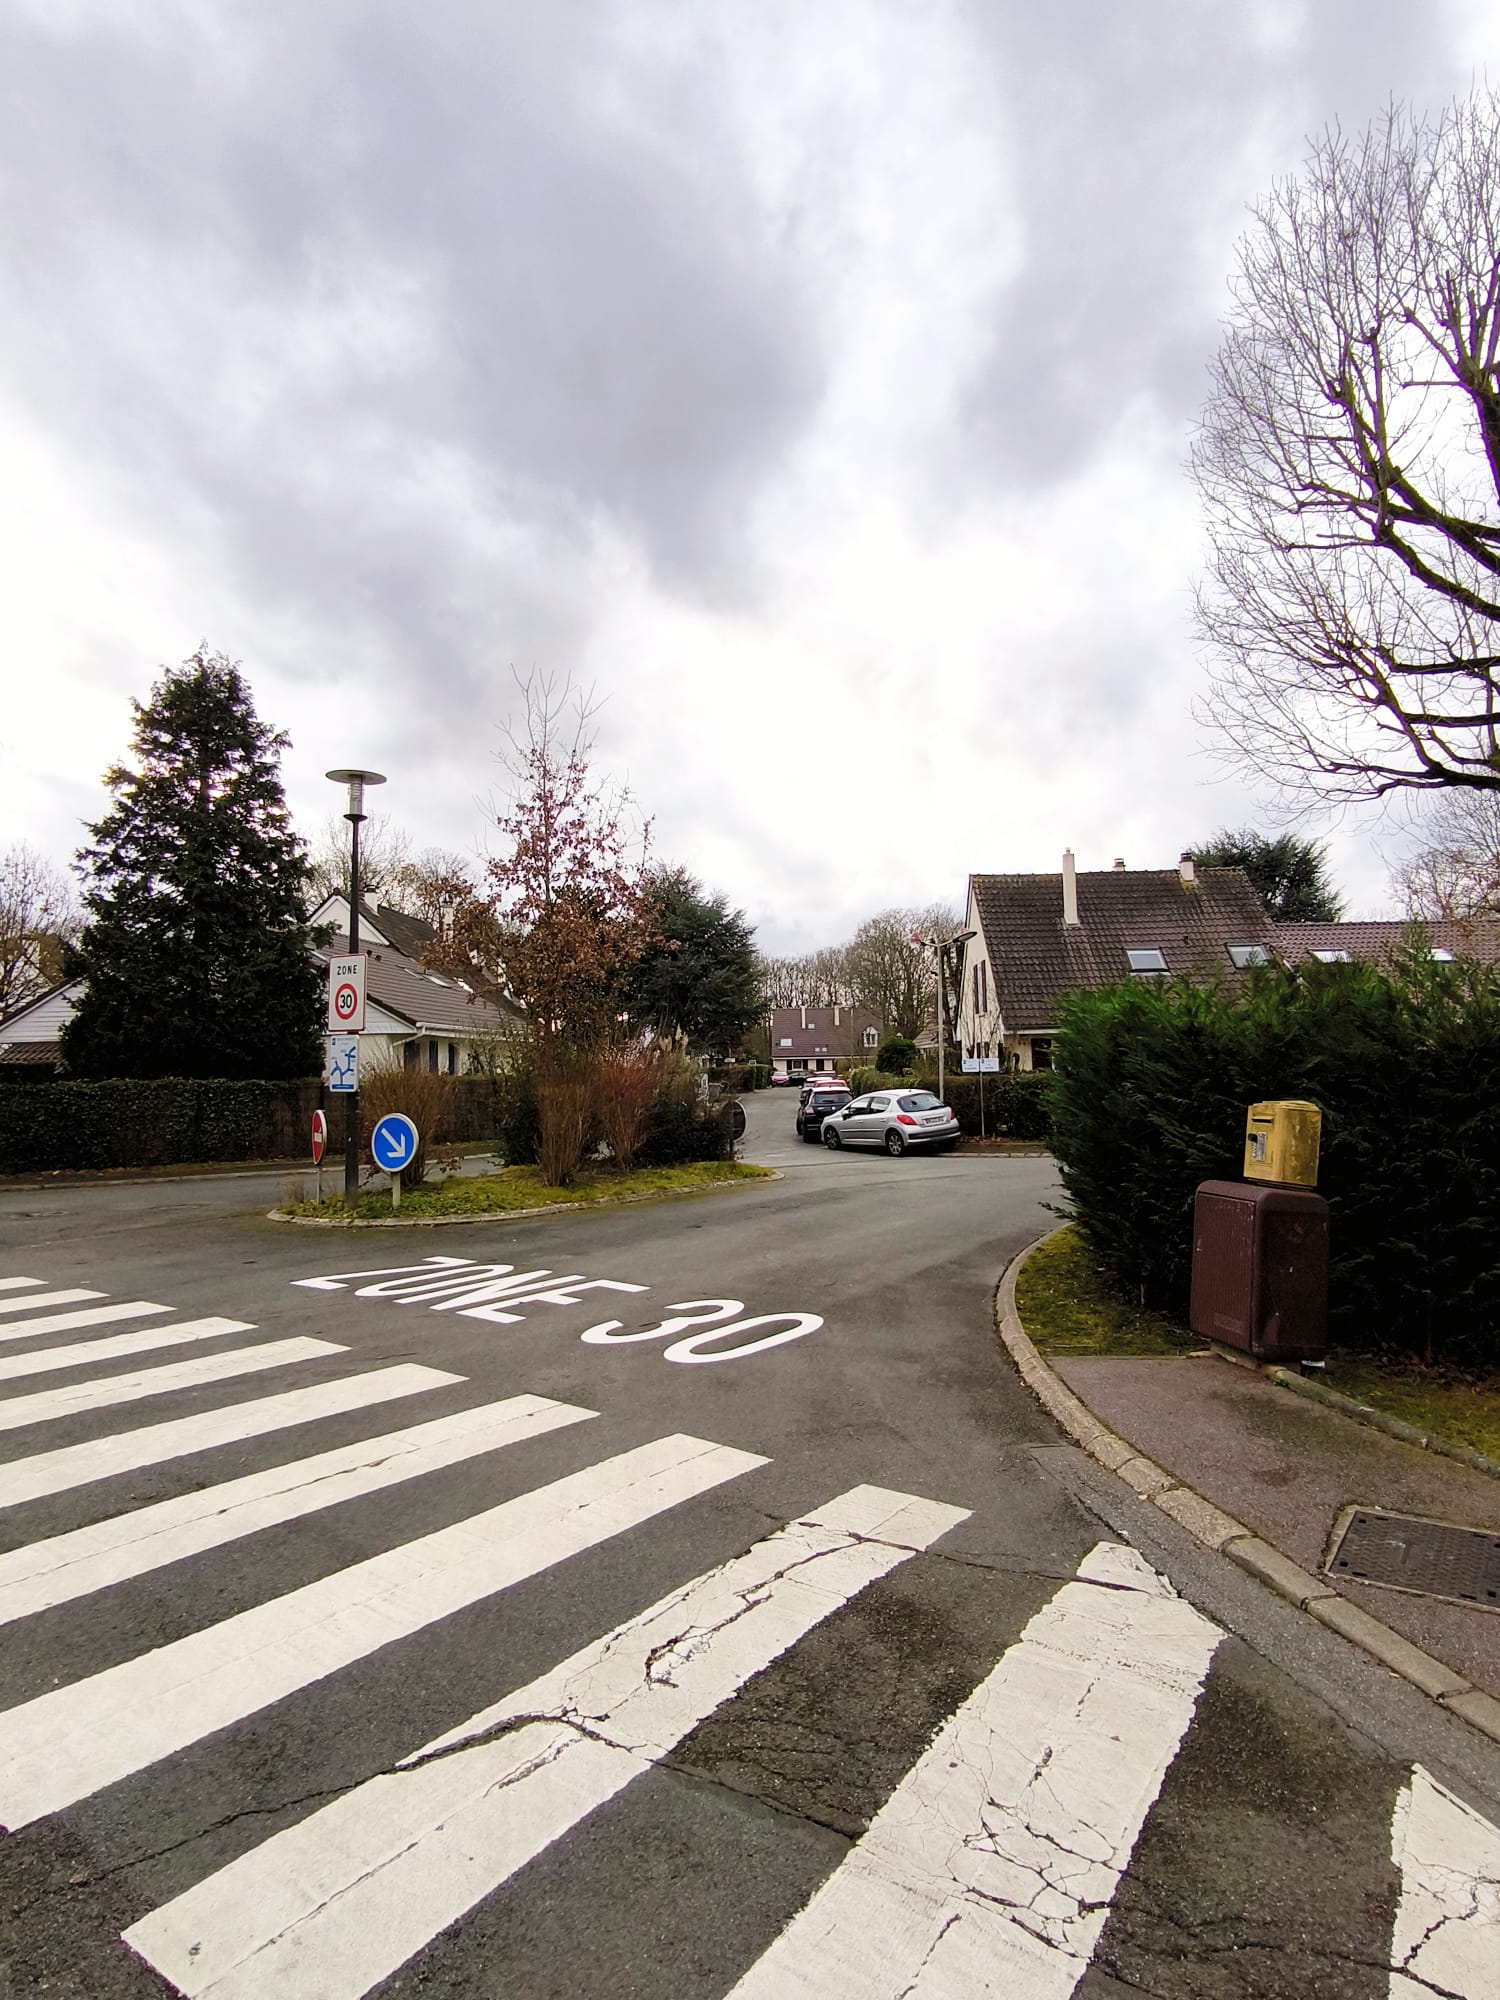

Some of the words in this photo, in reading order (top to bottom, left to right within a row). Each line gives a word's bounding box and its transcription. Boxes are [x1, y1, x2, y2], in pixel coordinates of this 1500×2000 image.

[337, 964, 358, 976] ZONE
[340, 994, 352, 1009] 30
[290, 1255, 651, 1324] ZONE
[580, 1298, 824, 1364] 30
